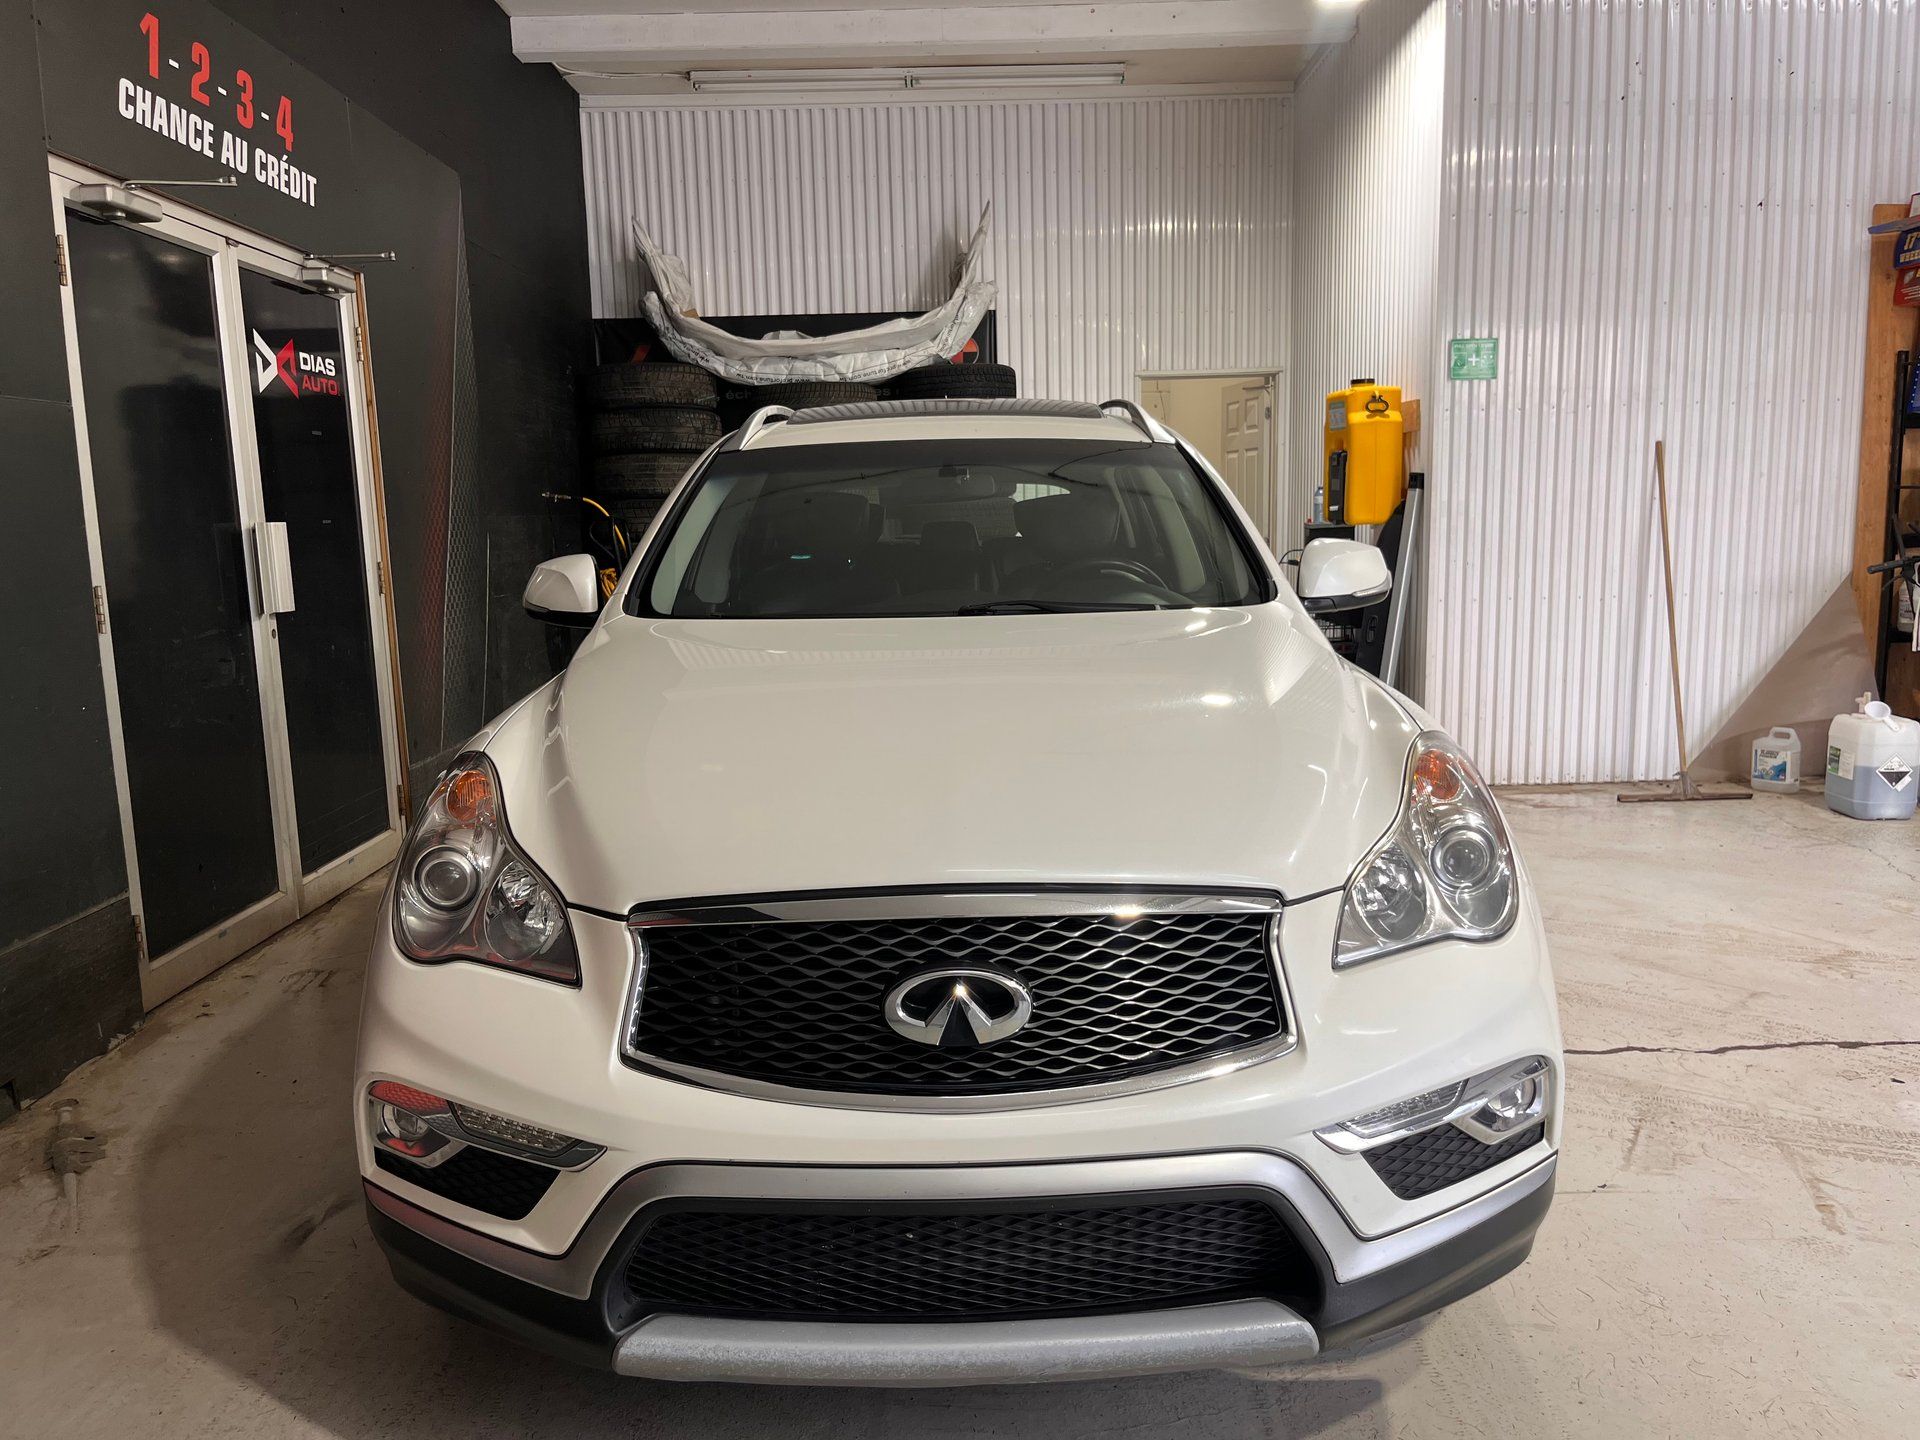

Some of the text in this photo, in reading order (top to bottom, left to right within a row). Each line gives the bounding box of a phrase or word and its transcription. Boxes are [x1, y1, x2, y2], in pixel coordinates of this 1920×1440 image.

[118, 77, 318, 207] CHANCE AU CRÉDIT
[298, 351, 336, 377] DIAS
[302, 374, 339, 396] AUTO
